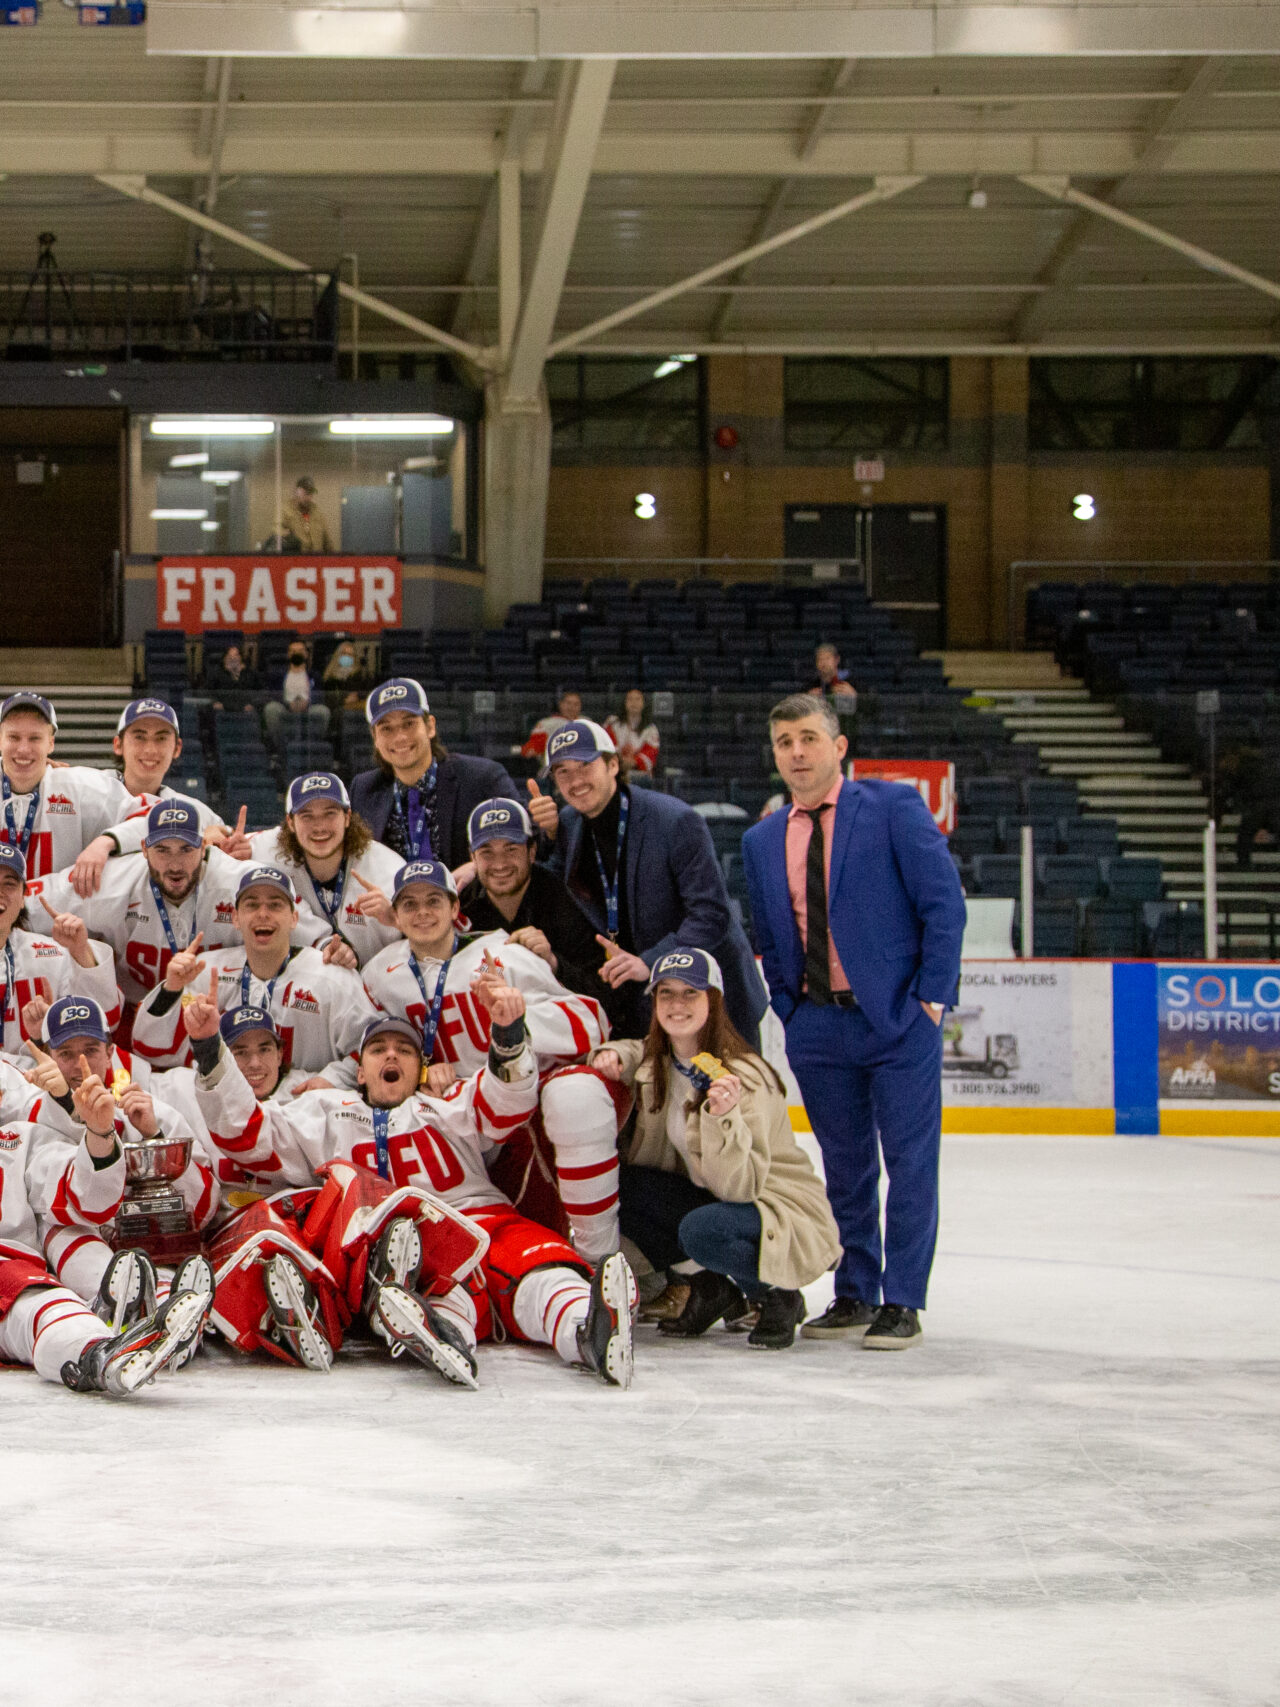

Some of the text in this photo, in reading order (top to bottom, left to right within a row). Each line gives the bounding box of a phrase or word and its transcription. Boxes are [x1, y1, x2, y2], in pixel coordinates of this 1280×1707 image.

[163, 567, 397, 623] FRASER
[1001, 974, 1057, 985] MOVERS
[1166, 975, 1280, 1008] SOLO
